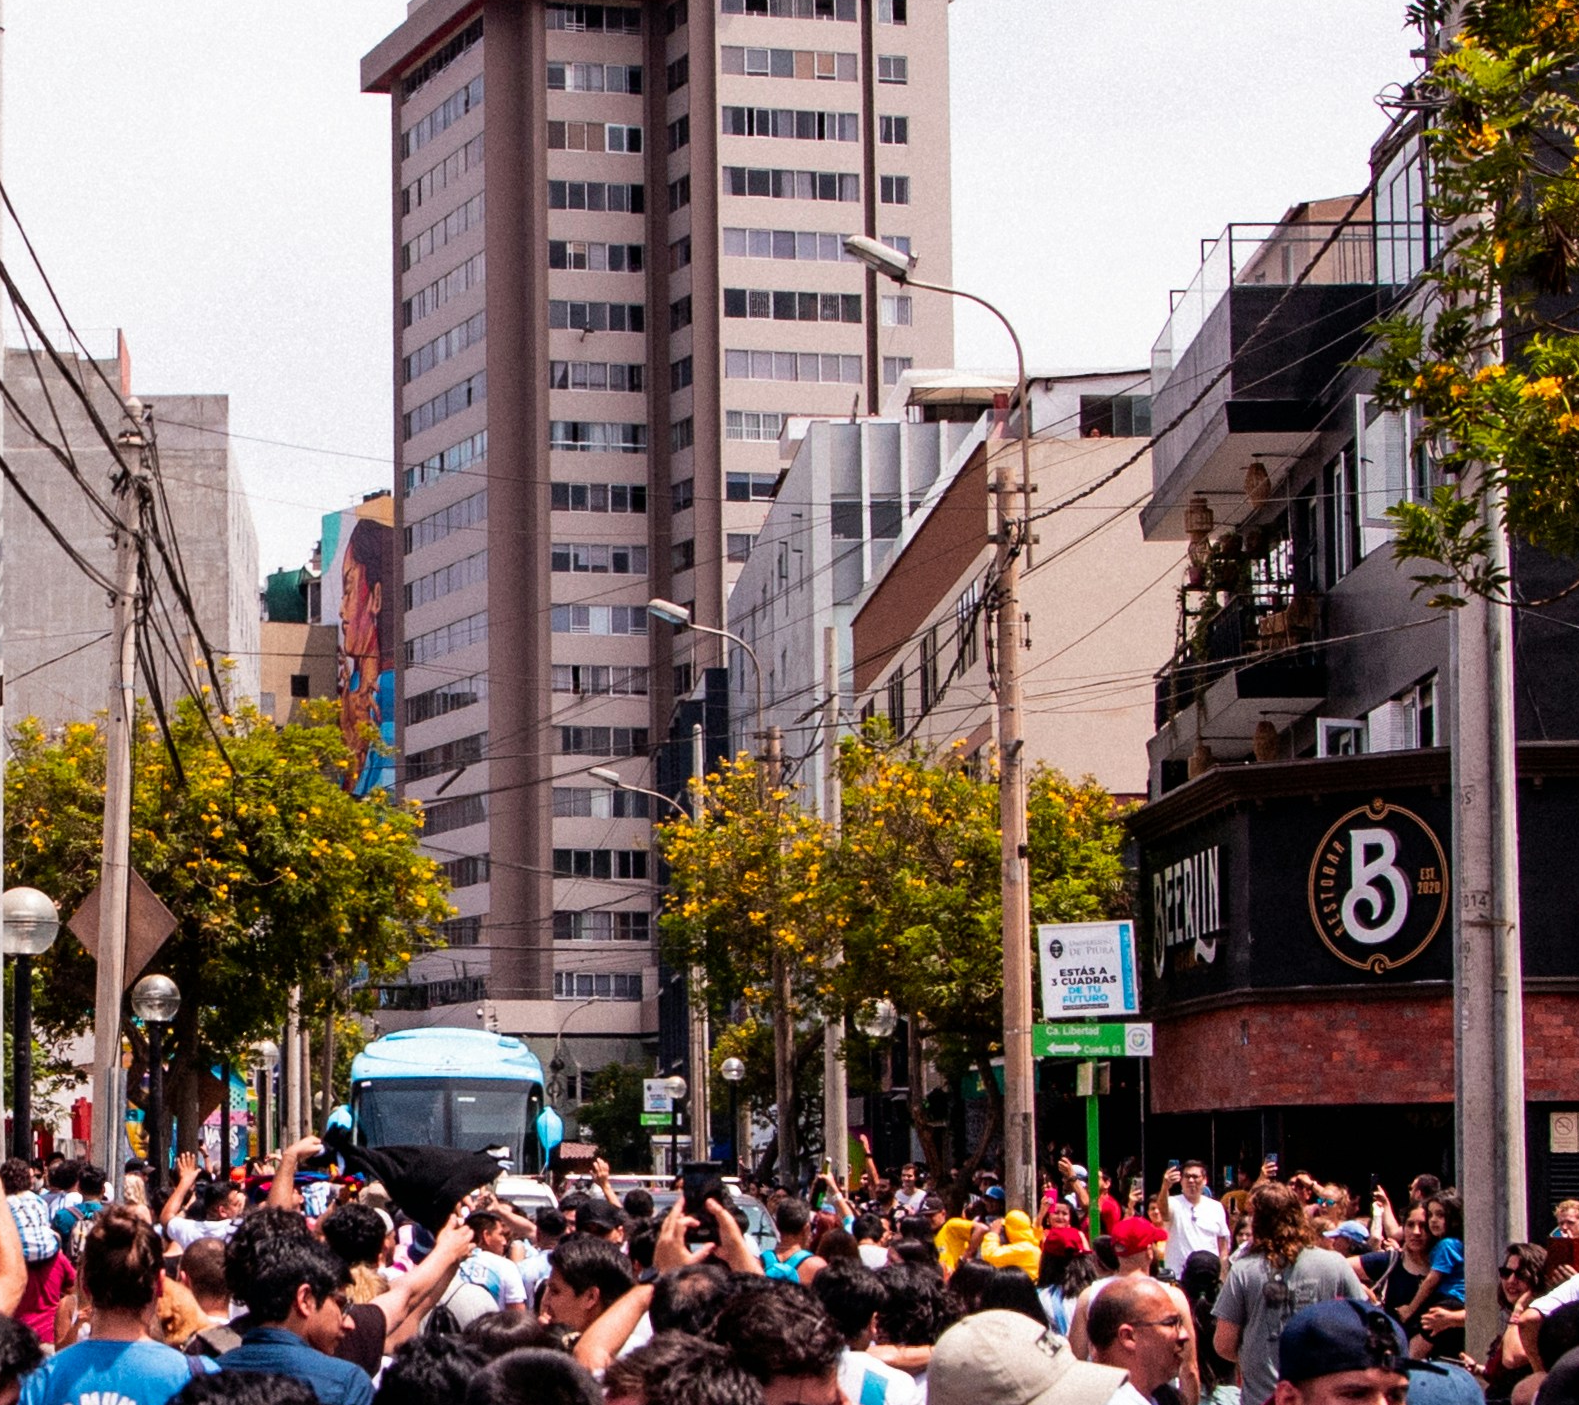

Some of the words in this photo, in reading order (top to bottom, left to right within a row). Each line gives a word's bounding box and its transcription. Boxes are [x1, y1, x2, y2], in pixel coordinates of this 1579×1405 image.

[1420, 868, 1437, 880] EST.
[1320, 840, 1346, 938] RESTOBAR
[1341, 827, 1410, 944] B
[1417, 881, 1442, 894] 2020
[1153, 845, 1220, 979] BEERLIN
[1059, 964, 1097, 977] ESTÁS
[1099, 966, 1108, 976] A
[1051, 978, 1058, 987] 3
[1061, 975, 1118, 986] CUADRAS
[1067, 987, 1083, 995] DE
[1086, 986, 1102, 994] TU
[1062, 994, 1109, 1004] FUTURO
[1063, 1026, 1100, 1036] Libertad
